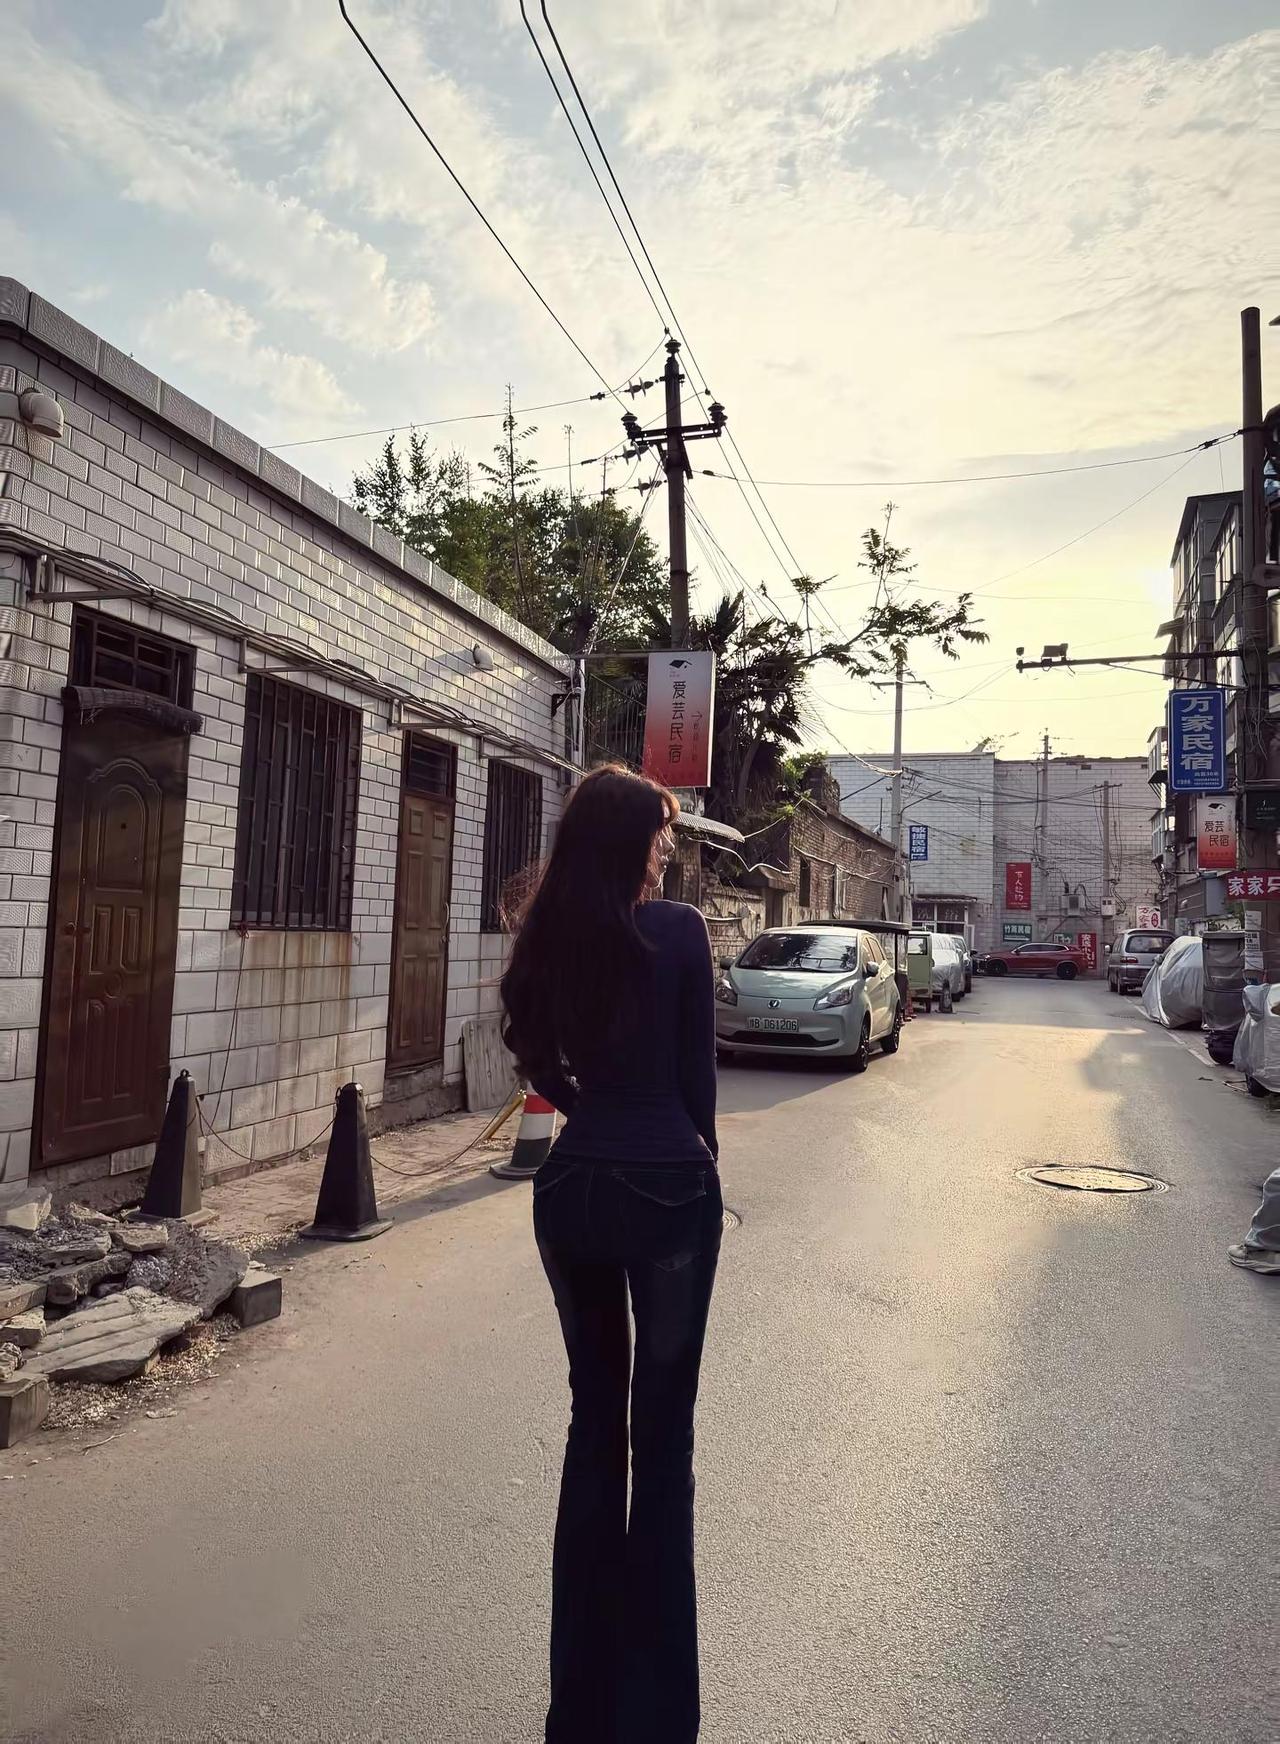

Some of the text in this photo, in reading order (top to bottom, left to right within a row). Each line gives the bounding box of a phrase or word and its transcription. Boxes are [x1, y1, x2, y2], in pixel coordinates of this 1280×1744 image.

[668, 680, 687, 764] 爱芸民宿
[1180, 696, 1215, 770] 万家民宿
[1204, 820, 1225, 833] 爱芸
[1209, 834, 1230, 847] 民宿
